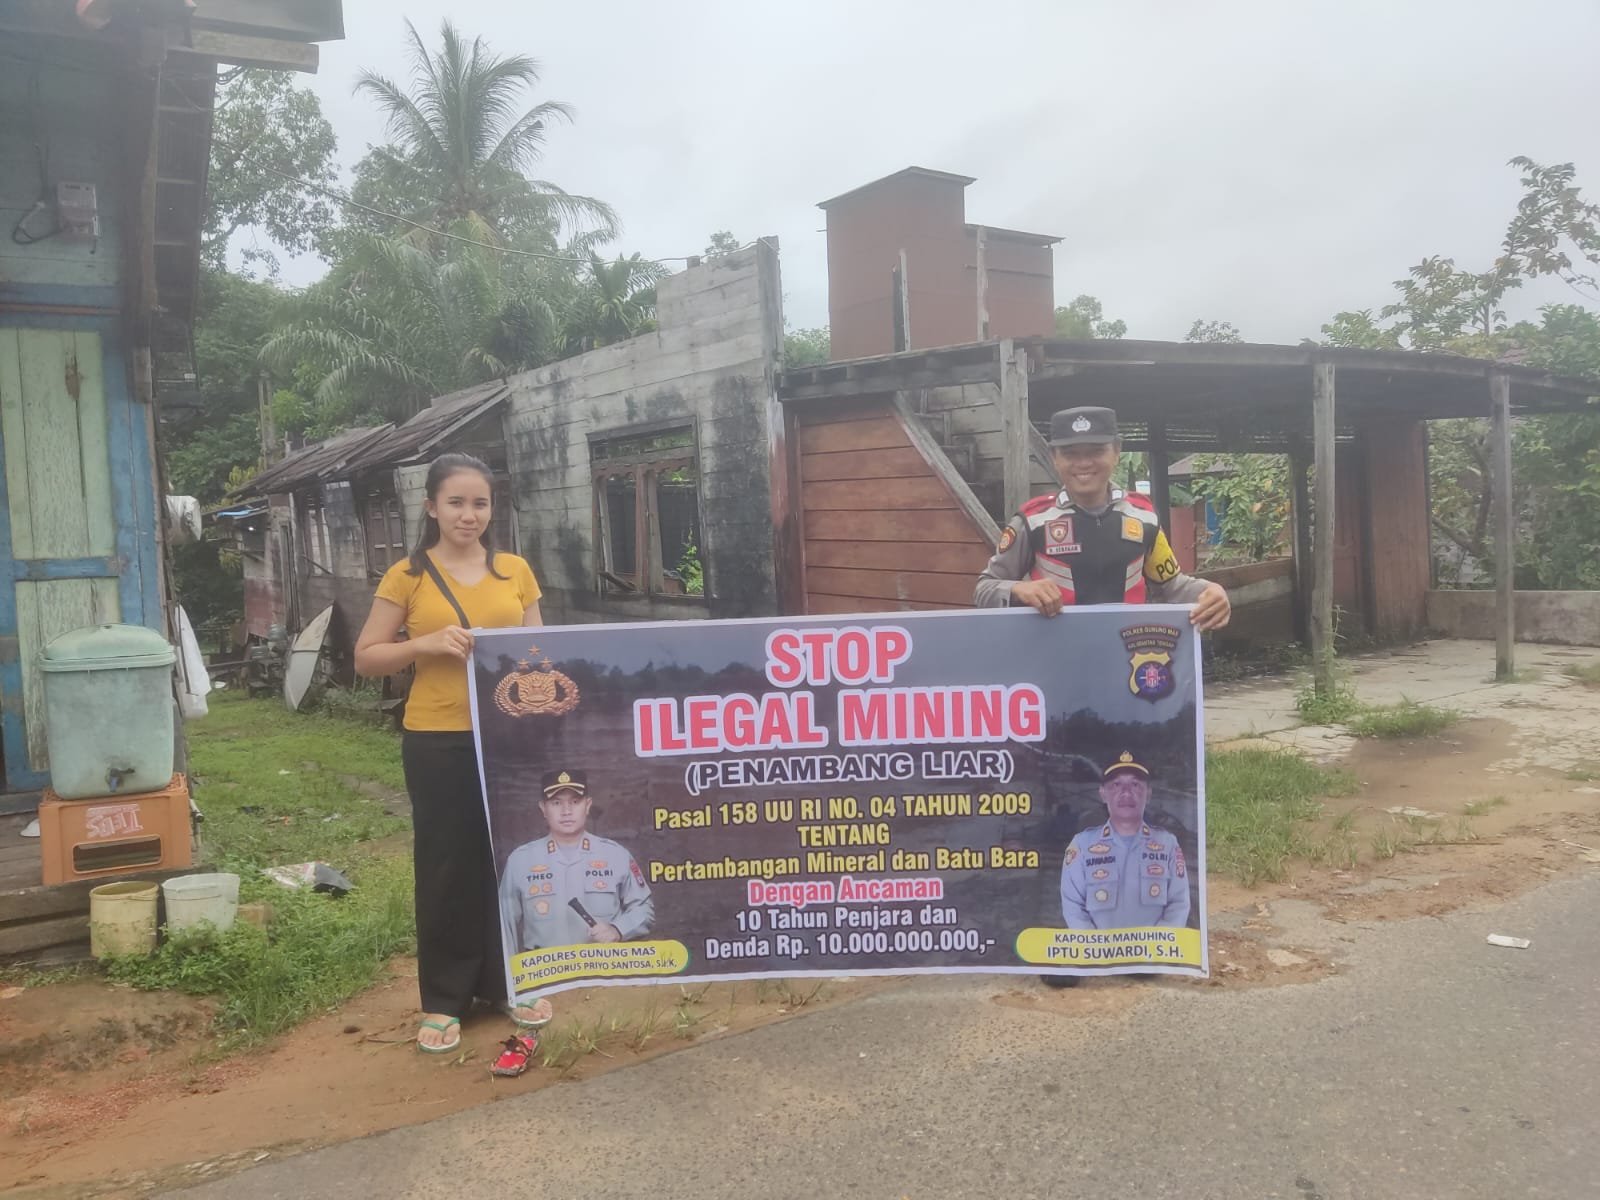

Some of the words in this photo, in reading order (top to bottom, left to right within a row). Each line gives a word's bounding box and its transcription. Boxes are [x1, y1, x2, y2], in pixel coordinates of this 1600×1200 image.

[768, 629, 909, 685] STOP
[637, 694, 825, 754] ILEGAL
[841, 687, 1043, 743] MINING
[687, 753, 914, 795] (PENAMBANG
[922, 751, 1013, 783] LIAR)
[654, 805, 712, 830] Pasal
[719, 802, 759, 825] 158
[765, 800, 793, 823] UU
[800, 799, 822, 821] RI
[829, 797, 864, 820] NO.
[870, 796, 896, 818] 04
[902, 794, 971, 817] TAHUN
[978, 793, 1032, 815] 2009
[797, 823, 890, 847] TENTANG
[650, 856, 800, 882] Pertambangan
[807, 850, 885, 873] Mineral
[892, 850, 929, 871] dan
[936, 848, 983, 869] Batu
[991, 847, 1039, 868] Bara
[1142, 853, 1168, 861] POLRI
[527, 873, 553, 881] THEO
[585, 869, 613, 877] POLRI
[749, 880, 833, 906] Dengan
[839, 876, 942, 901] Ancaman
[736, 910, 761, 932] 10
[768, 907, 828, 930] Tahun
[835, 906, 913, 931] Penjara
[920, 905, 957, 926] dan
[706, 936, 769, 959] Denda
[777, 934, 809, 961] Rp.
[816, 929, 995, 955] 10.000.000.000,-
[1055, 933, 1110, 944] KAPOLSEK
[1112, 932, 1175, 942] MANUHING
[521, 951, 577, 969] KAPOLRES
[579, 948, 628, 959] GUNUNG
[631, 947, 656, 956] MAS
[1047, 946, 1079, 959] IPTU
[1083, 945, 1153, 960] SUWARDI,
[1156, 945, 1184, 958] S.H.
[528, 963, 582, 980] THEODORUS
[583, 962, 609, 971] PRIYO
